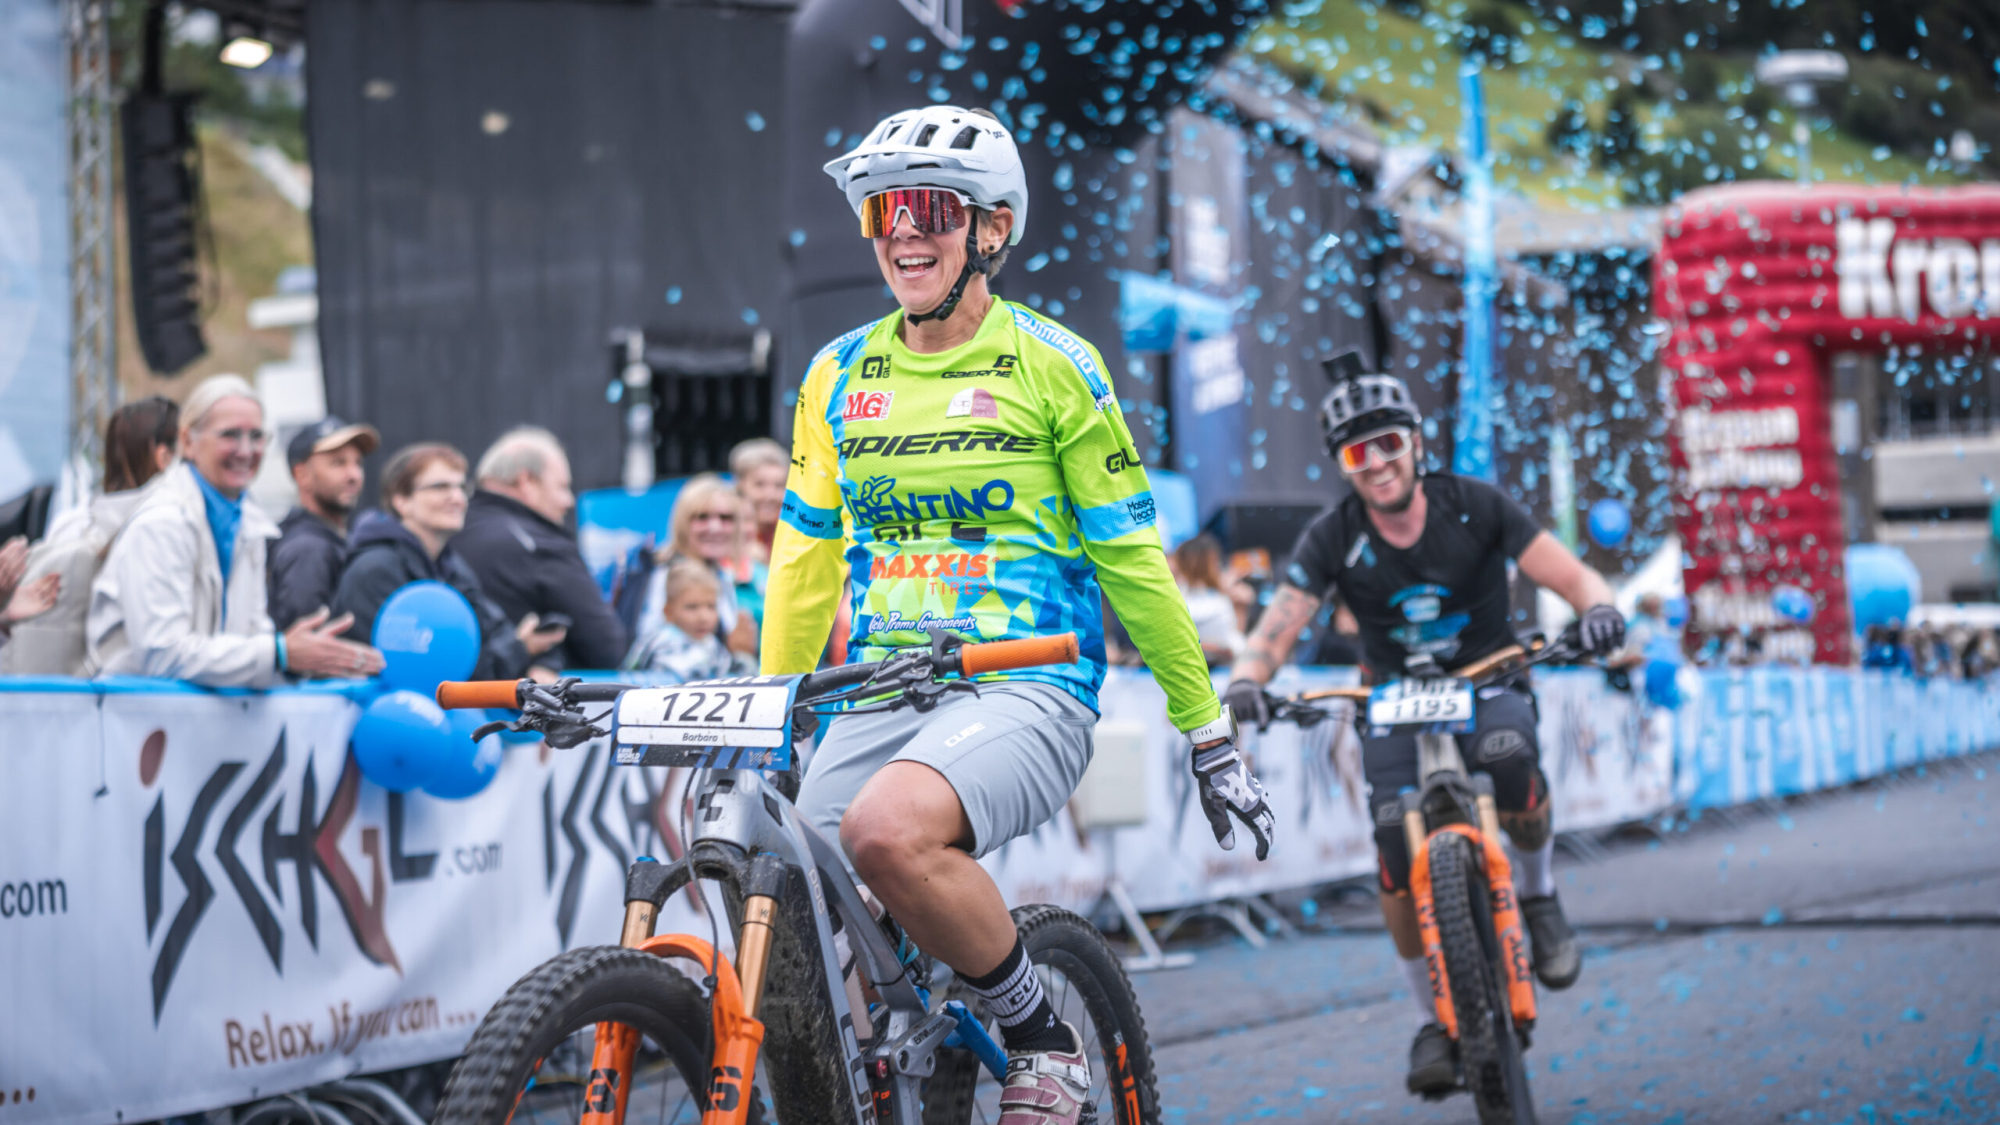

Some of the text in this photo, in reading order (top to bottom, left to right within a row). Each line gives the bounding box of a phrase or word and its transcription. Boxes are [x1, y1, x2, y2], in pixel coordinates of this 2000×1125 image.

[1014, 312, 1095, 375] SHIMANO
[843, 391, 887, 420] MG
[838, 431, 1041, 460] APIERRE
[868, 553, 990, 580] MAXXIS
[929, 582, 988, 595] TIRES
[885, 611, 917, 633] Promo
[917, 611, 977, 634] Components
[662, 692, 756, 723] 1221
[1394, 699, 1458, 720] 1195
[682, 732, 719, 742] Barbara
[944, 721, 987, 748] CUBE
[224, 1011, 324, 1069] Relax.
